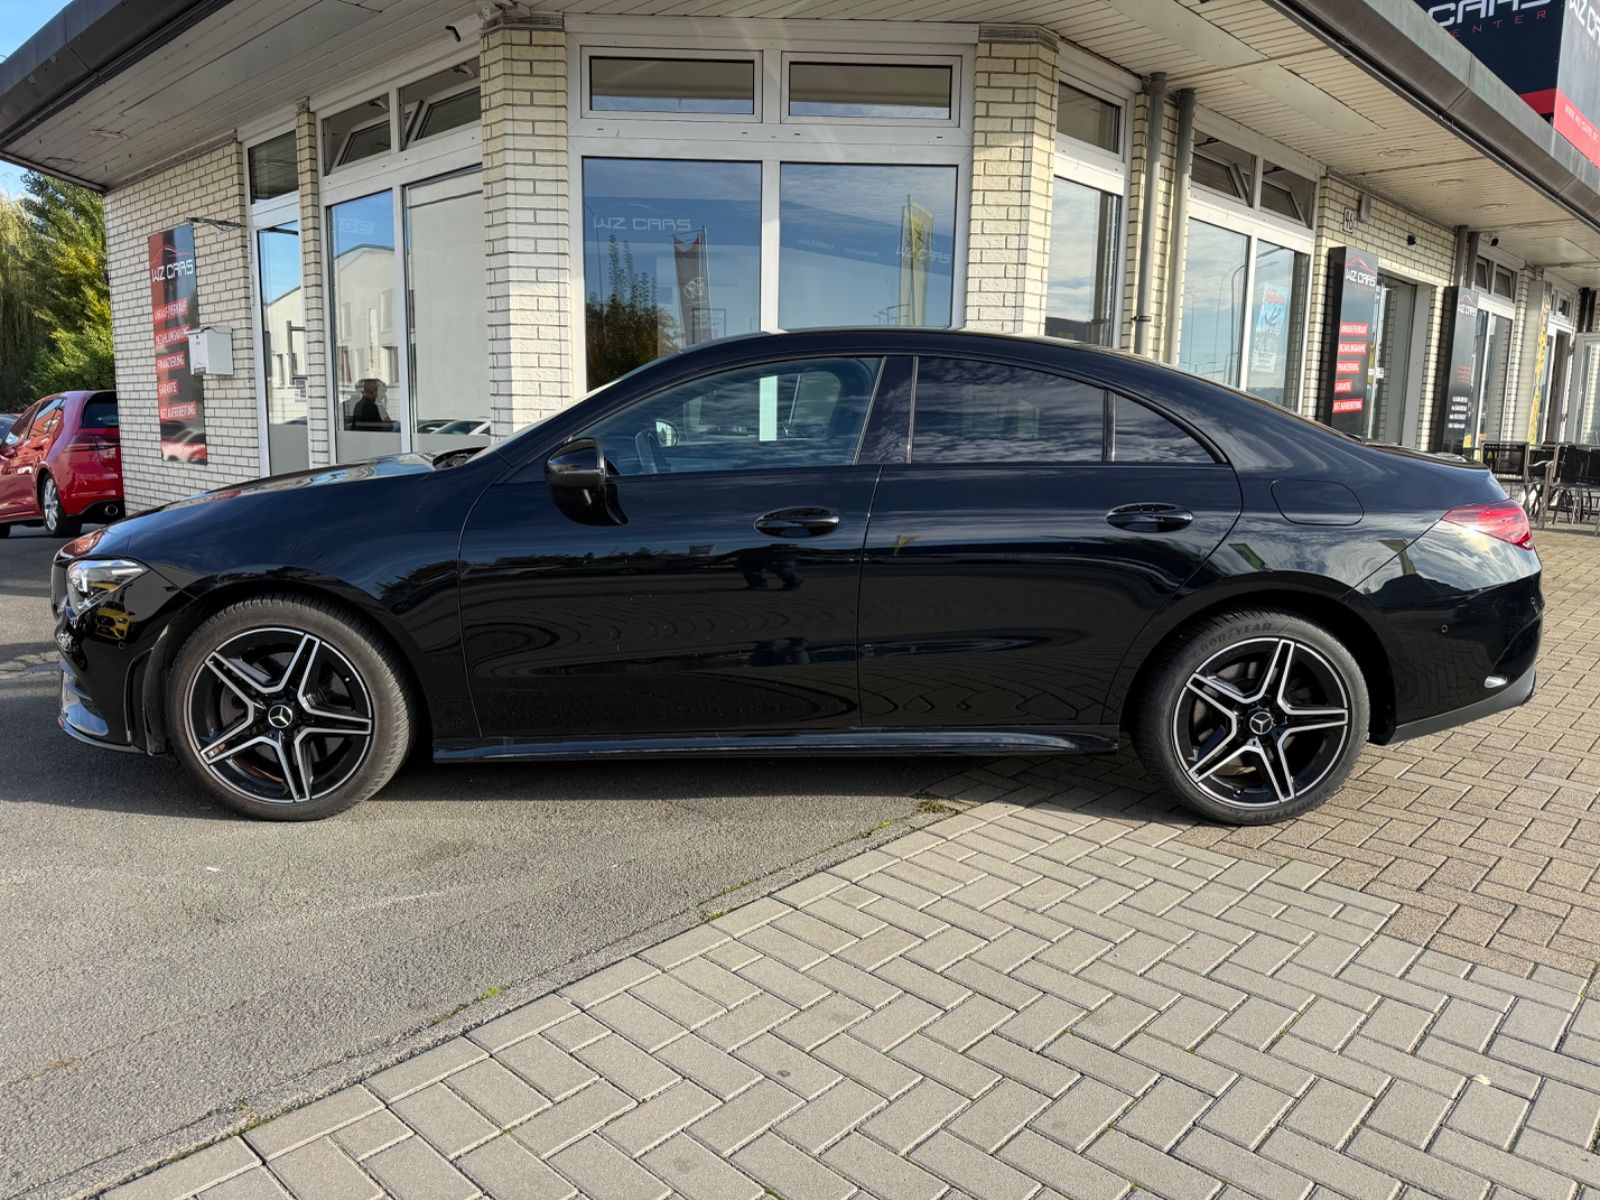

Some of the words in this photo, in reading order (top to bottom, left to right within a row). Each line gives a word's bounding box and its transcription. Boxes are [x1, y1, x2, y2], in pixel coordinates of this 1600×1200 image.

[594, 217, 627, 229] WZ
[632, 218, 692, 232] CARS
[152, 265, 166, 282] WZ
[166, 259, 195, 280] CARS
[1345, 268, 1357, 283] WZ
[1357, 271, 1377, 288] CARS
[1193, 623, 1272, 660] GOODYEAR
